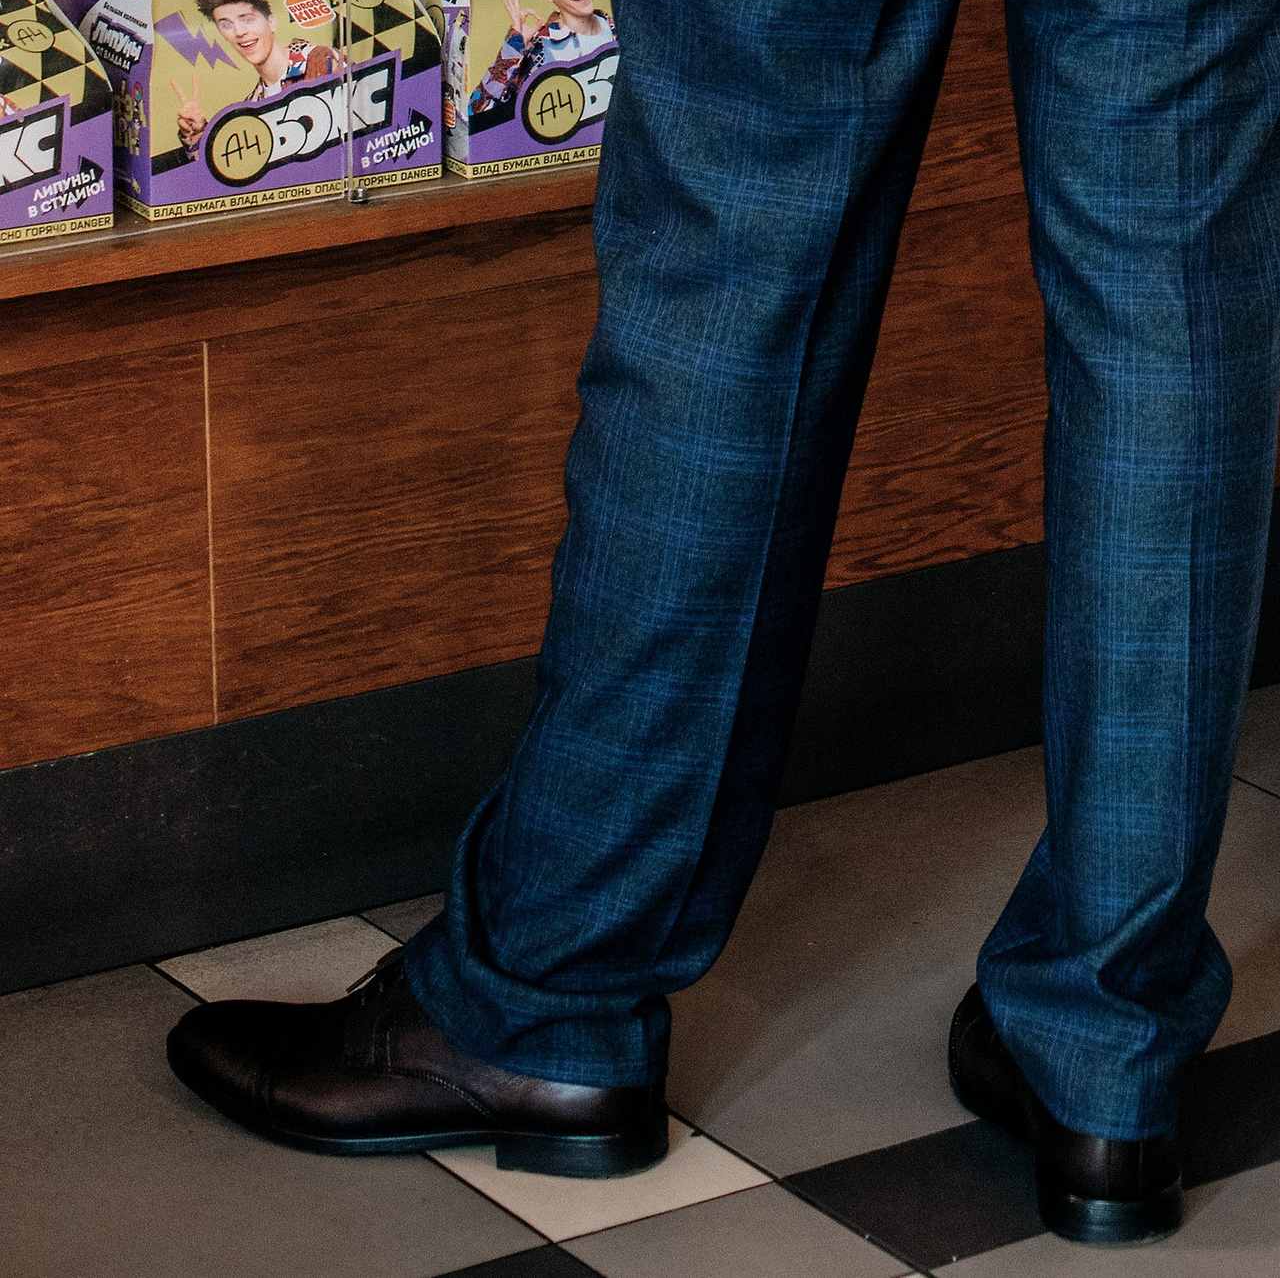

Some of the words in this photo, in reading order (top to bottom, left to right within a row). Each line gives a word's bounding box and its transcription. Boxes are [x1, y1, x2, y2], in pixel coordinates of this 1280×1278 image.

[294, 5, 331, 23] KING
[361, 156, 371, 169] В
[373, 132, 434, 165] СТУДИЮ!
[365, 120, 425, 152] ЛИПУНЫ
[472, 166, 500, 176] ВЛАД
[503, 158, 540, 171] БУМАГА
[543, 152, 570, 164] ВЛАД
[28, 206, 38, 218] В
[40, 180, 105, 213] СТУДИЮ!
[33, 168, 96, 202] ЛИПУНЫ
[153, 206, 183, 218] ВЛАД
[186, 200, 227, 214] БУМАГА
[230, 194, 259, 207] ВЛАД
[278, 186, 311, 199] ОГОНЬ
[358, 174, 398, 187] ГОРЯЧО
[400, 167, 439, 182] DANGER
[25, 223, 67, 237] ГОРЯЧО
[70, 217, 111, 231] DANGER
